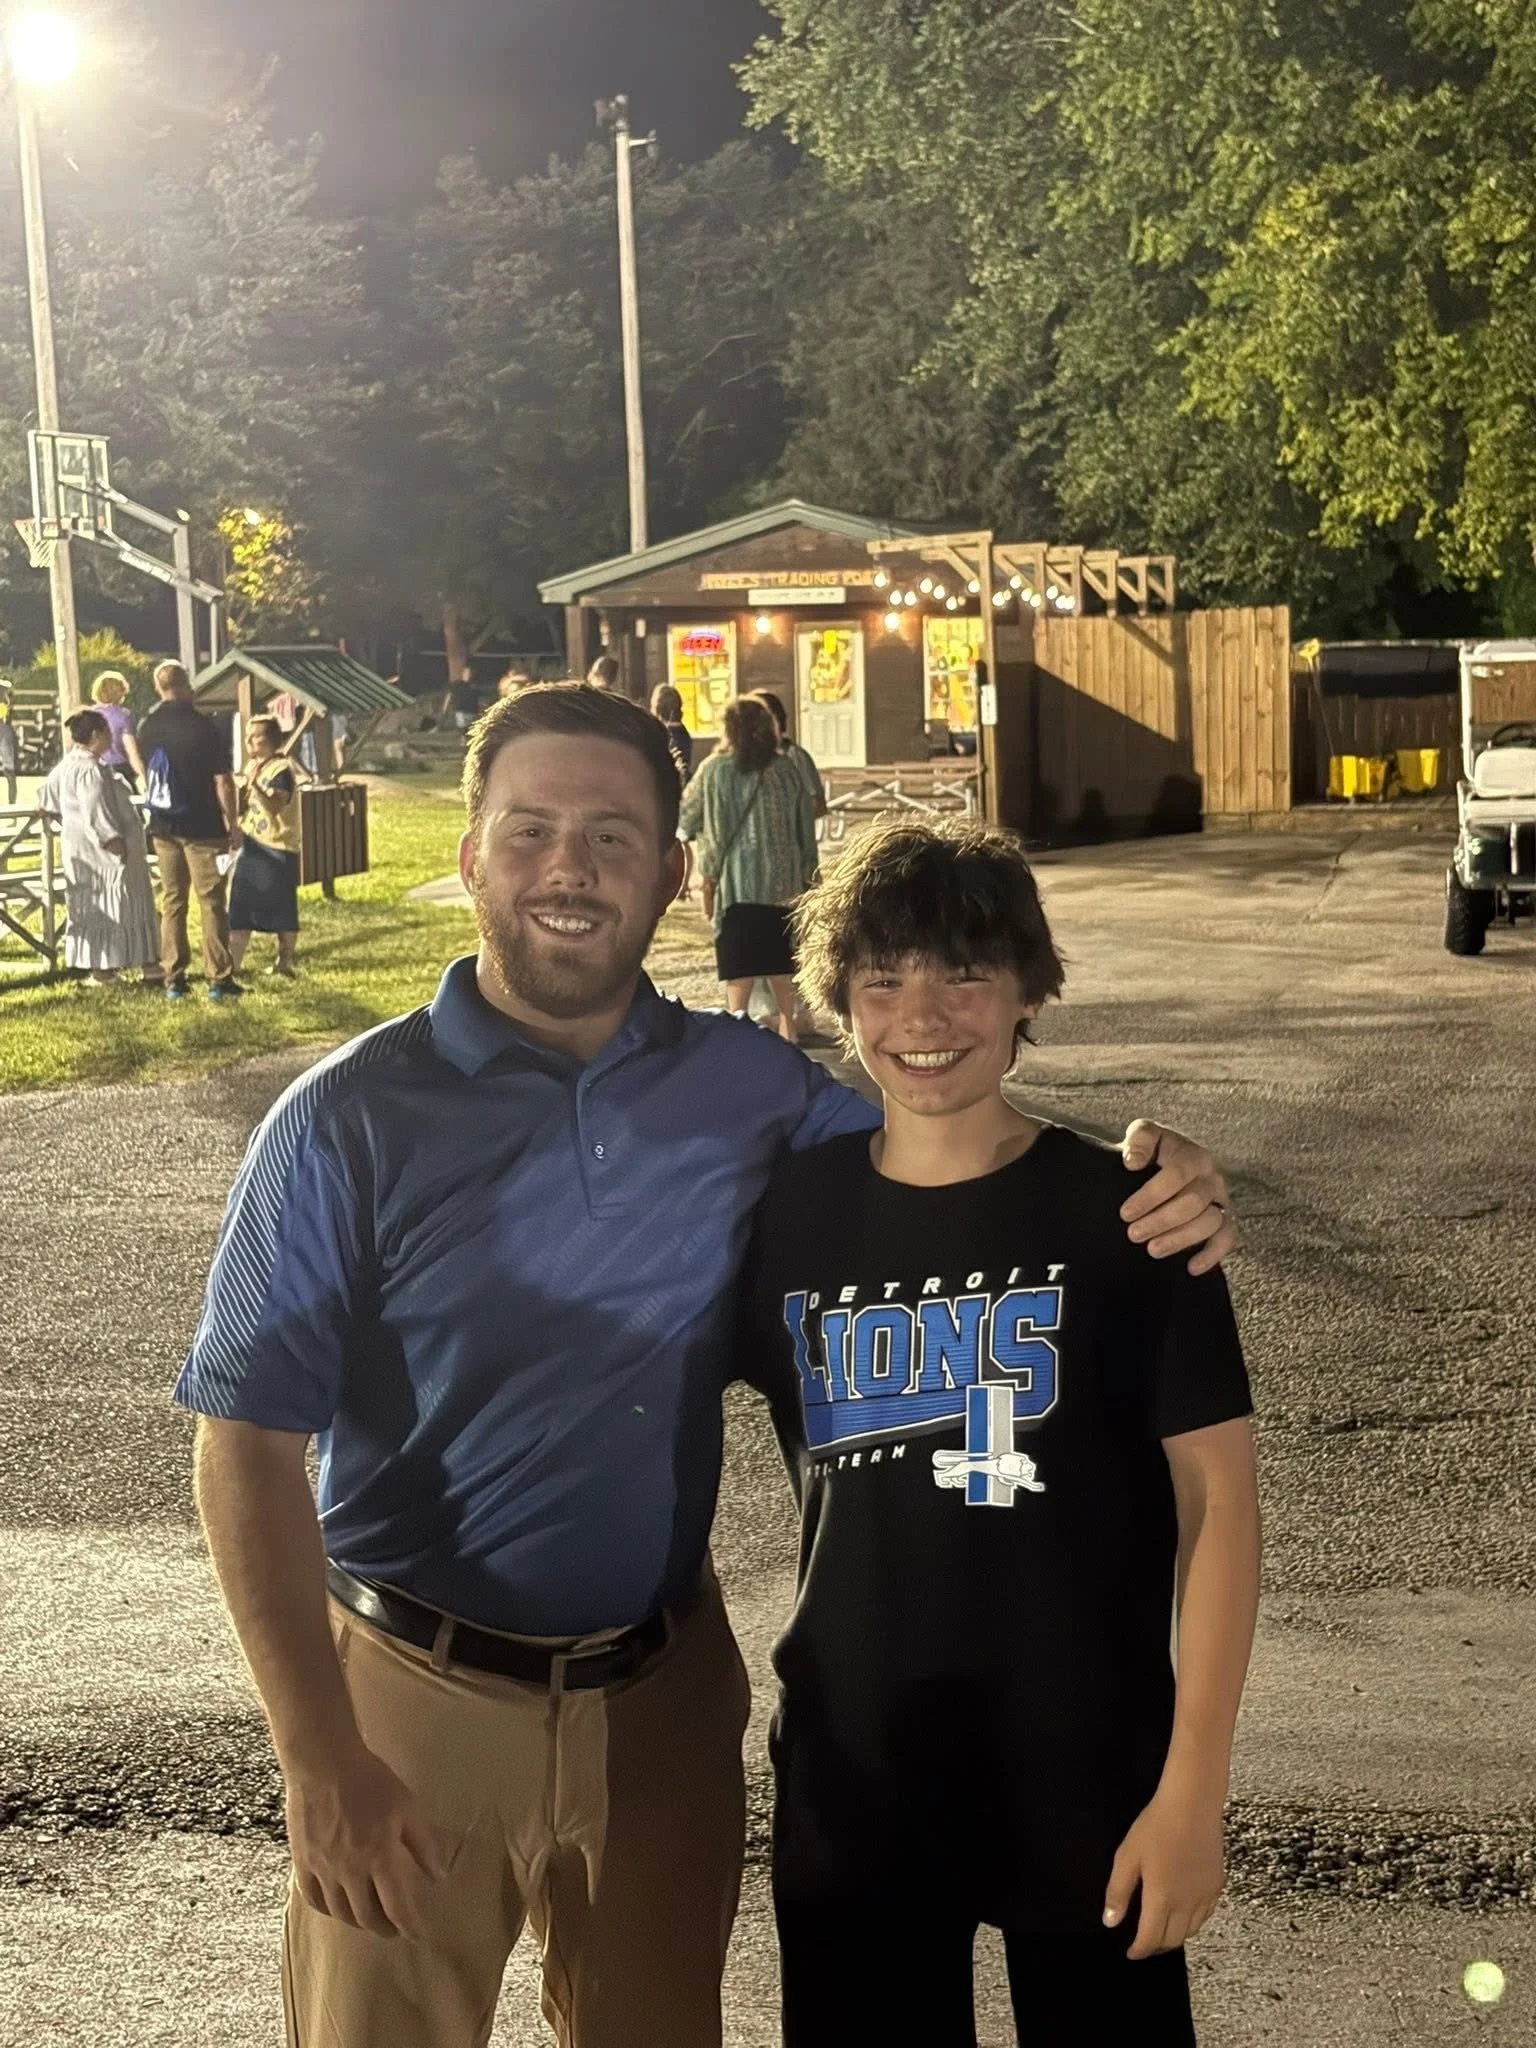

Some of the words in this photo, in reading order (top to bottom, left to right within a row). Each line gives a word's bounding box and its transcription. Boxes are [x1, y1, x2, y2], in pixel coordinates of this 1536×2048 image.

[768, 571, 837, 587] TRADING
[808, 1263, 1065, 1311] DETROIT
[784, 1286, 1064, 1423] LIONS
[837, 1443, 907, 1471] TEAM
